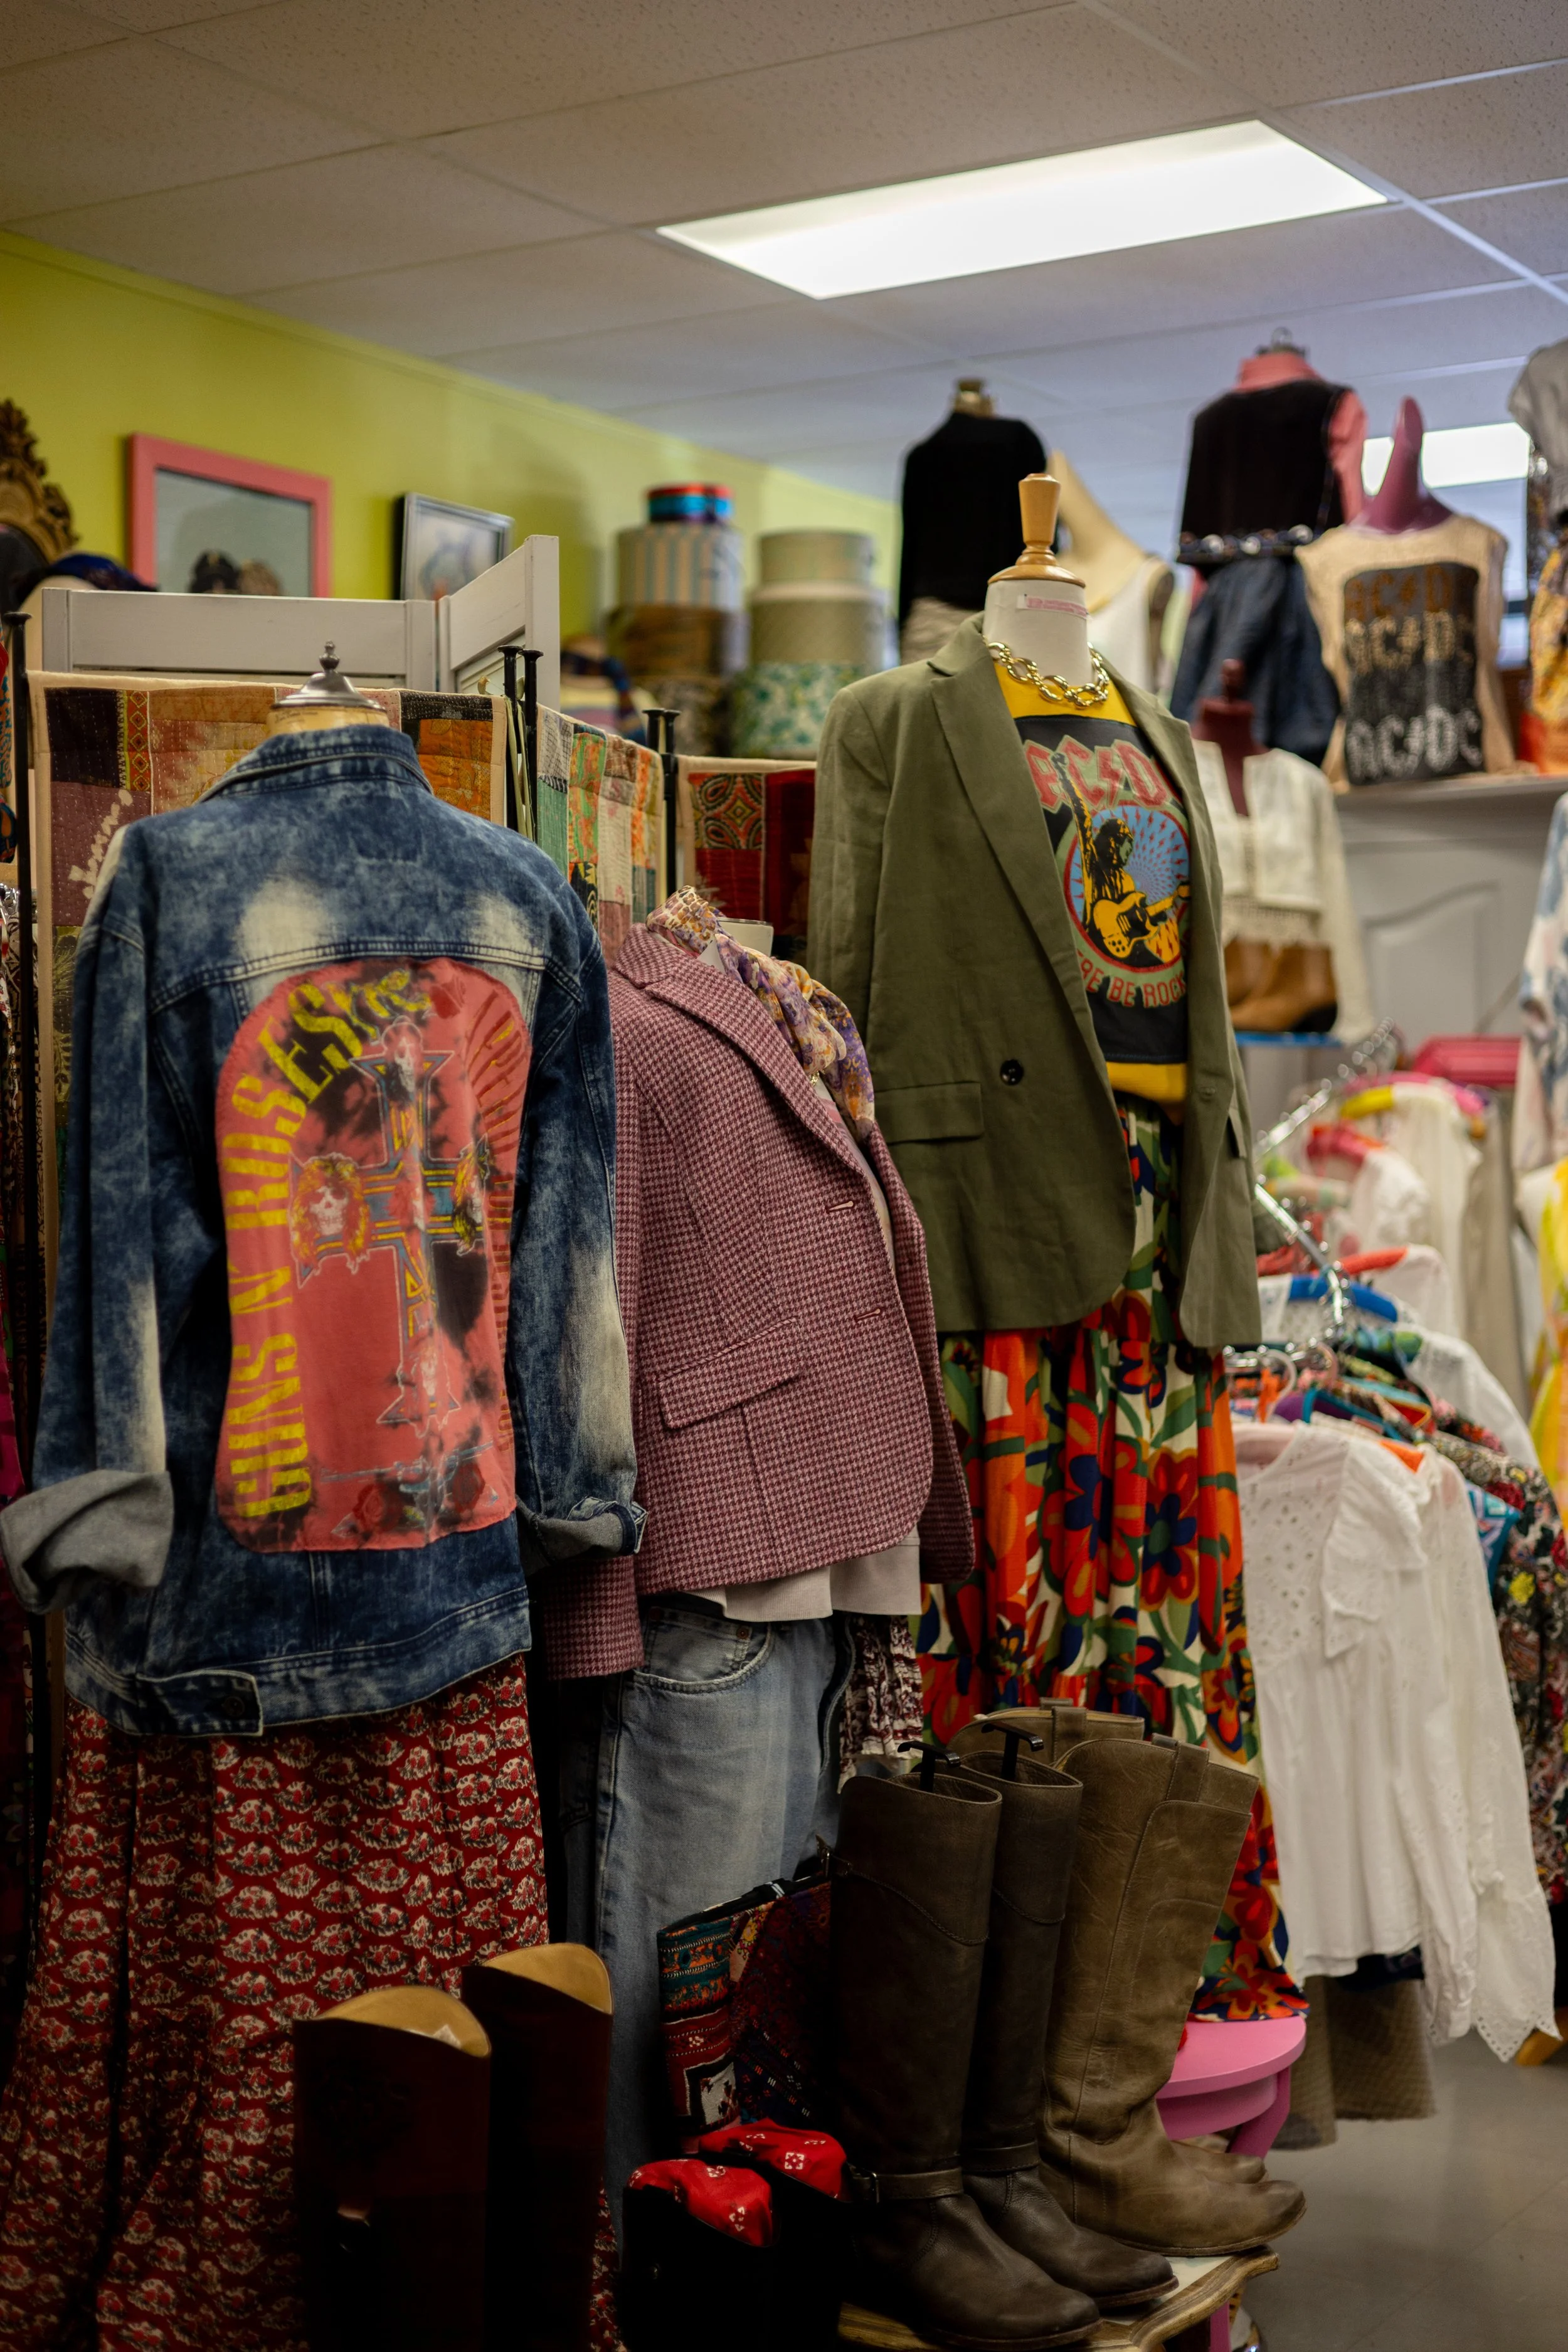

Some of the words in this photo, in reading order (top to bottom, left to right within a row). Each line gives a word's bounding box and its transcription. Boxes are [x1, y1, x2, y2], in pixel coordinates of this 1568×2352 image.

[1108, 976, 1136, 1007] BE
[1141, 972, 1186, 1009] ROCK
[222, 982, 363, 1230] ROSES
[226, 1333, 312, 1518] GUNS
